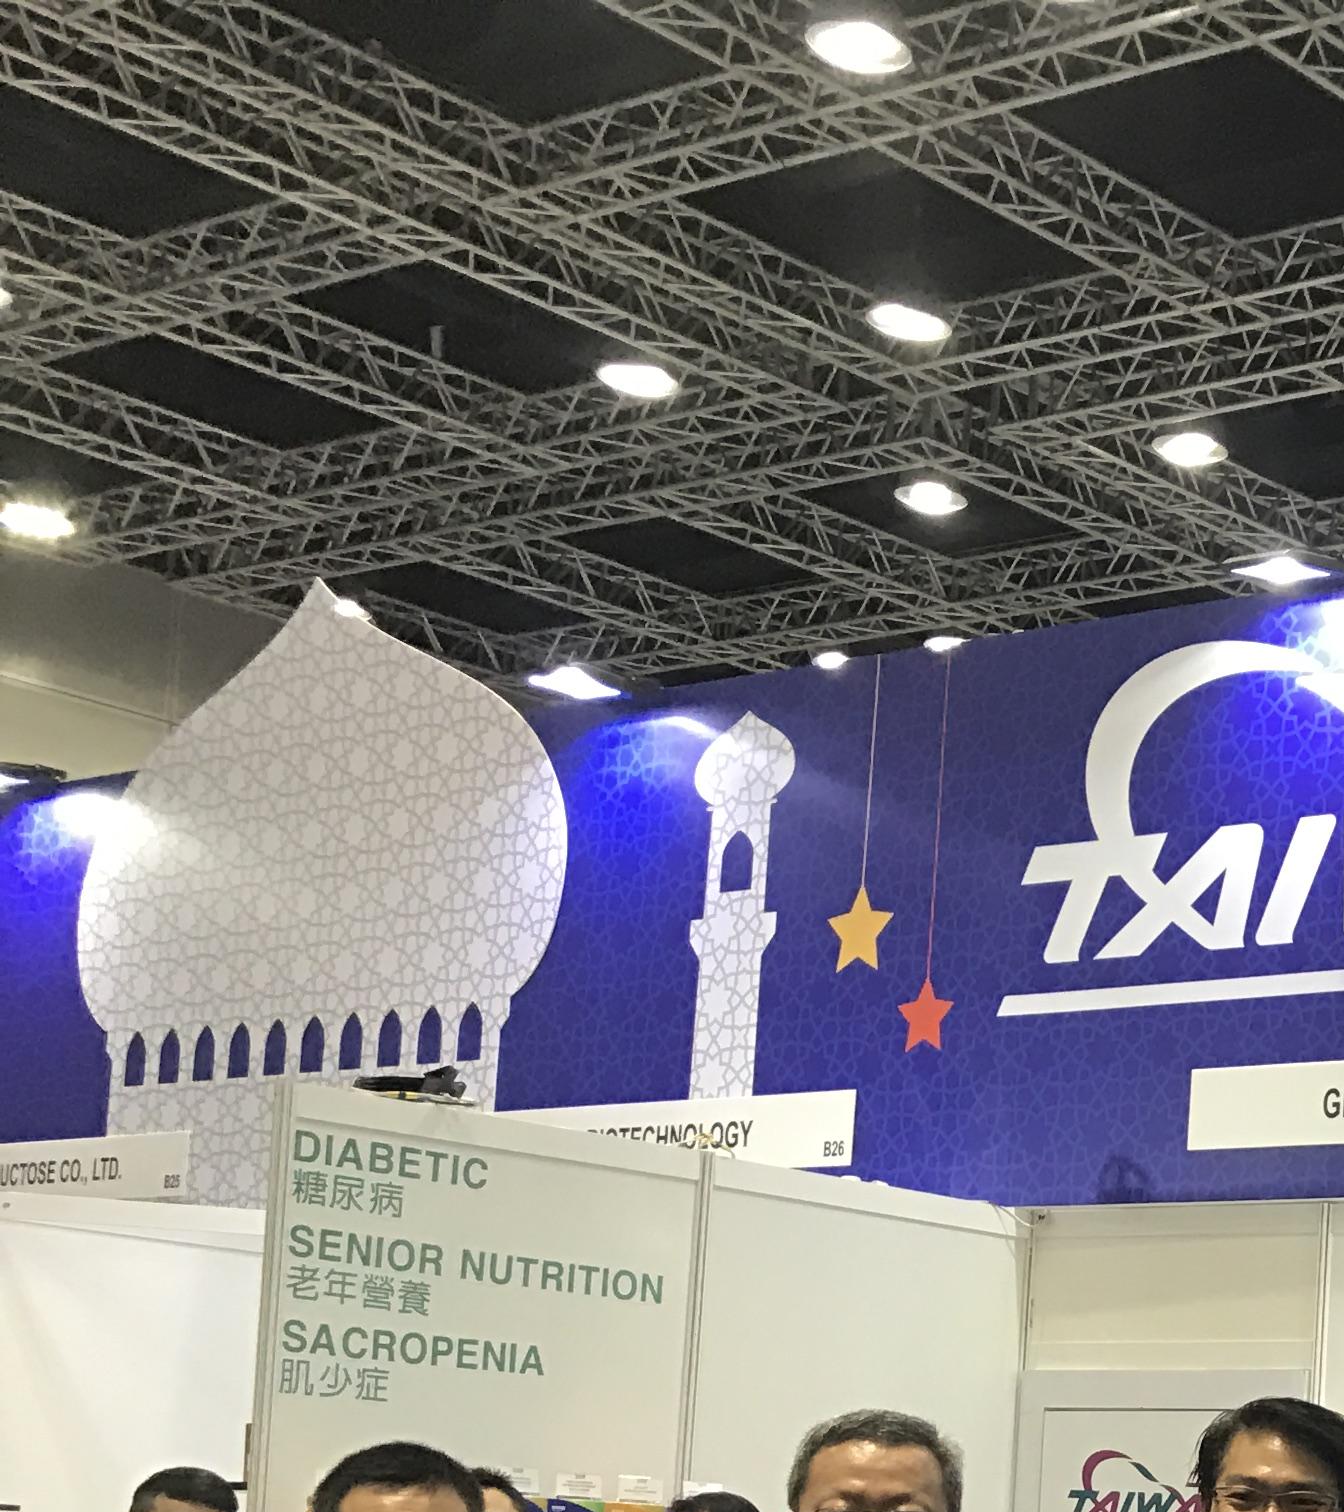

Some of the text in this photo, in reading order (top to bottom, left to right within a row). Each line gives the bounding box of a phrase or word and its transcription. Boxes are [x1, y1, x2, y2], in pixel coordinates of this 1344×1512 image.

[587, 1119, 754, 1150] TECHNOLOGY
[823, 1140, 845, 1157] B26
[59, 1158, 88, 1186] CO.,
[92, 1156, 123, 1182] LTD.
[163, 1174, 181, 1189] B25
[293, 1129, 489, 1190] DIABETIC
[291, 1167, 405, 1219] 糖尿病
[288, 1223, 664, 1305] SENIOR NUTRITION
[286, 1263, 432, 1317] 老年營養
[281, 1318, 545, 1377] SACROPENIA
[278, 1357, 390, 1403] 肌少症
